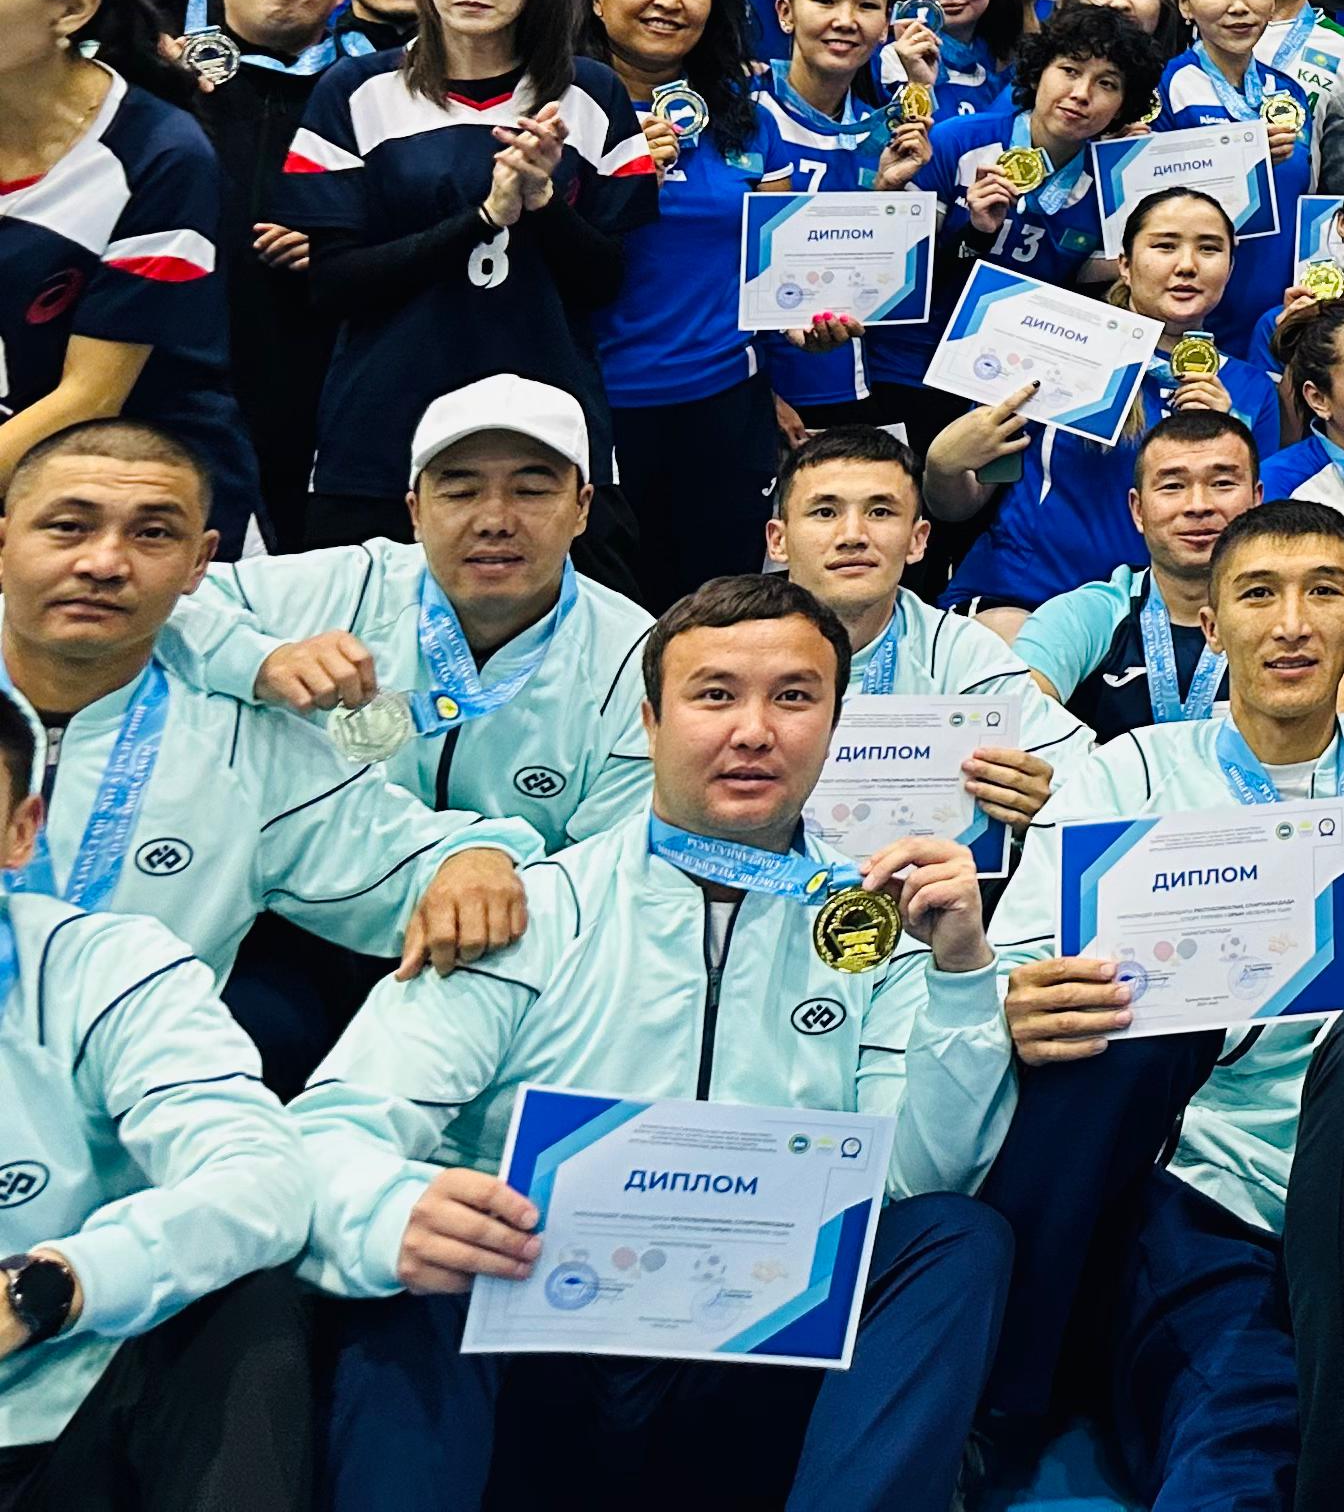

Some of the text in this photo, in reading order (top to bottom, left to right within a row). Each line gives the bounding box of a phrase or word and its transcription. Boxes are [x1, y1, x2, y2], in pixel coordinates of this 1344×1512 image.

[1297, 68, 1334, 92] KAZ
[799, 158, 827, 194] 7
[1153, 158, 1213, 177] ДИПЛОМ
[808, 229, 874, 242] ДИПЛОМ
[991, 219, 1045, 262] 13
[1021, 315, 1088, 345] ДИПЛОМ
[836, 746, 930, 763] ДИПЛОМ
[1153, 865, 1258, 892] ДИПЛОМ
[624, 1170, 759, 1196] ДИПЛОМ
